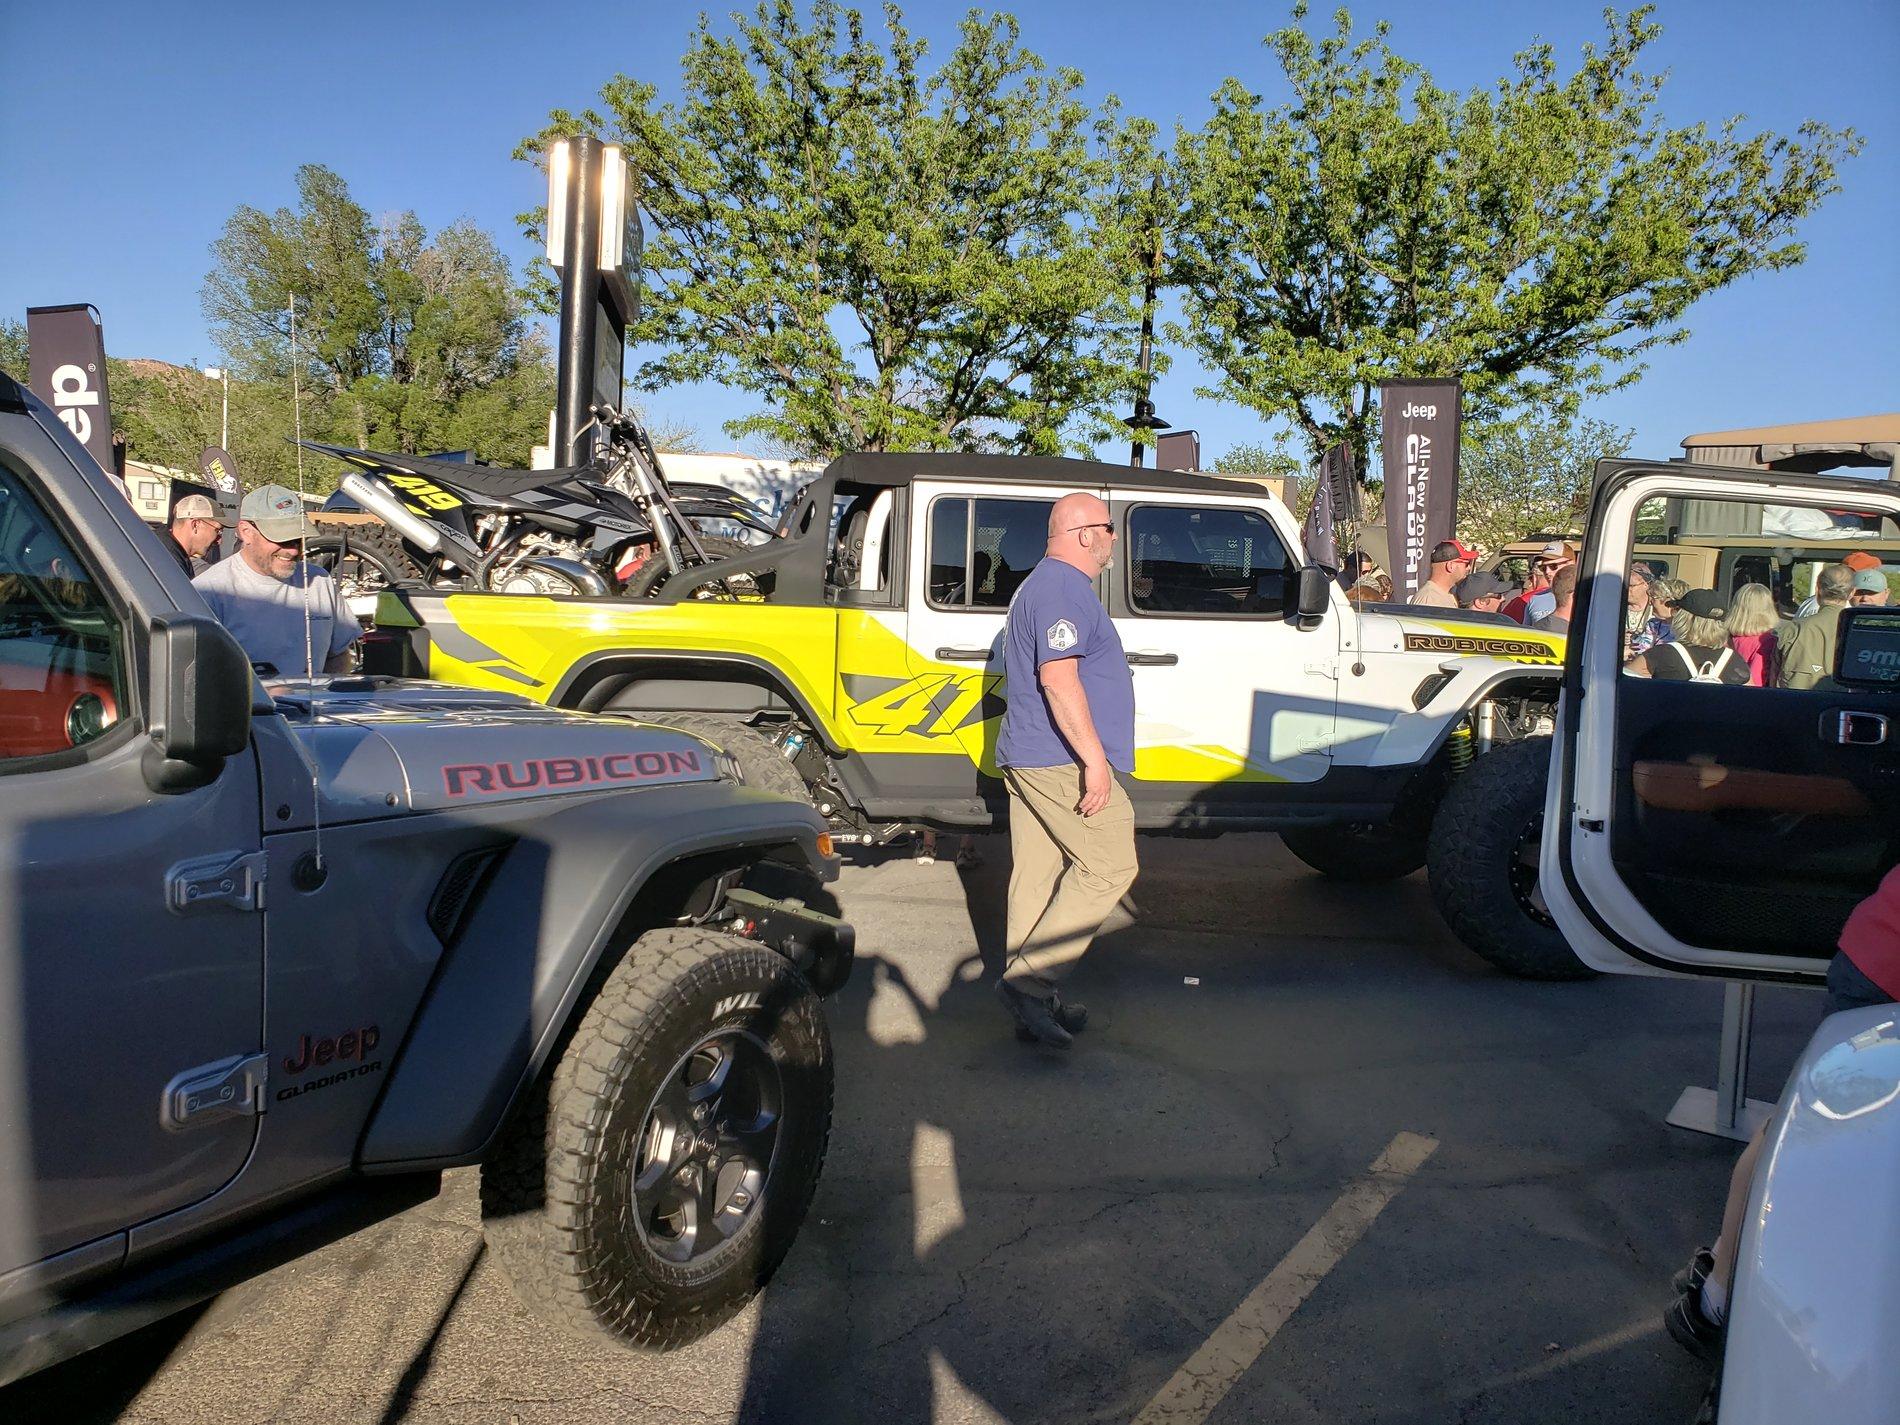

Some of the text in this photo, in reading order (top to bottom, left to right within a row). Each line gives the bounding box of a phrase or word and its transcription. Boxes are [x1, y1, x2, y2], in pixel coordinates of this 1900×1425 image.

[52, 364, 99, 445] ep
[1402, 402, 1437, 421] Jeep
[386, 474, 463, 511] 419
[1416, 434, 1431, 561] All-New 2020
[1406, 433, 1420, 605] GLADIAT
[1408, 635, 1548, 656] RUBICON
[441, 749, 702, 798] RUBICON
[282, 1025, 380, 1075] Jeep
[276, 1061, 382, 1102] GLADIATOR
